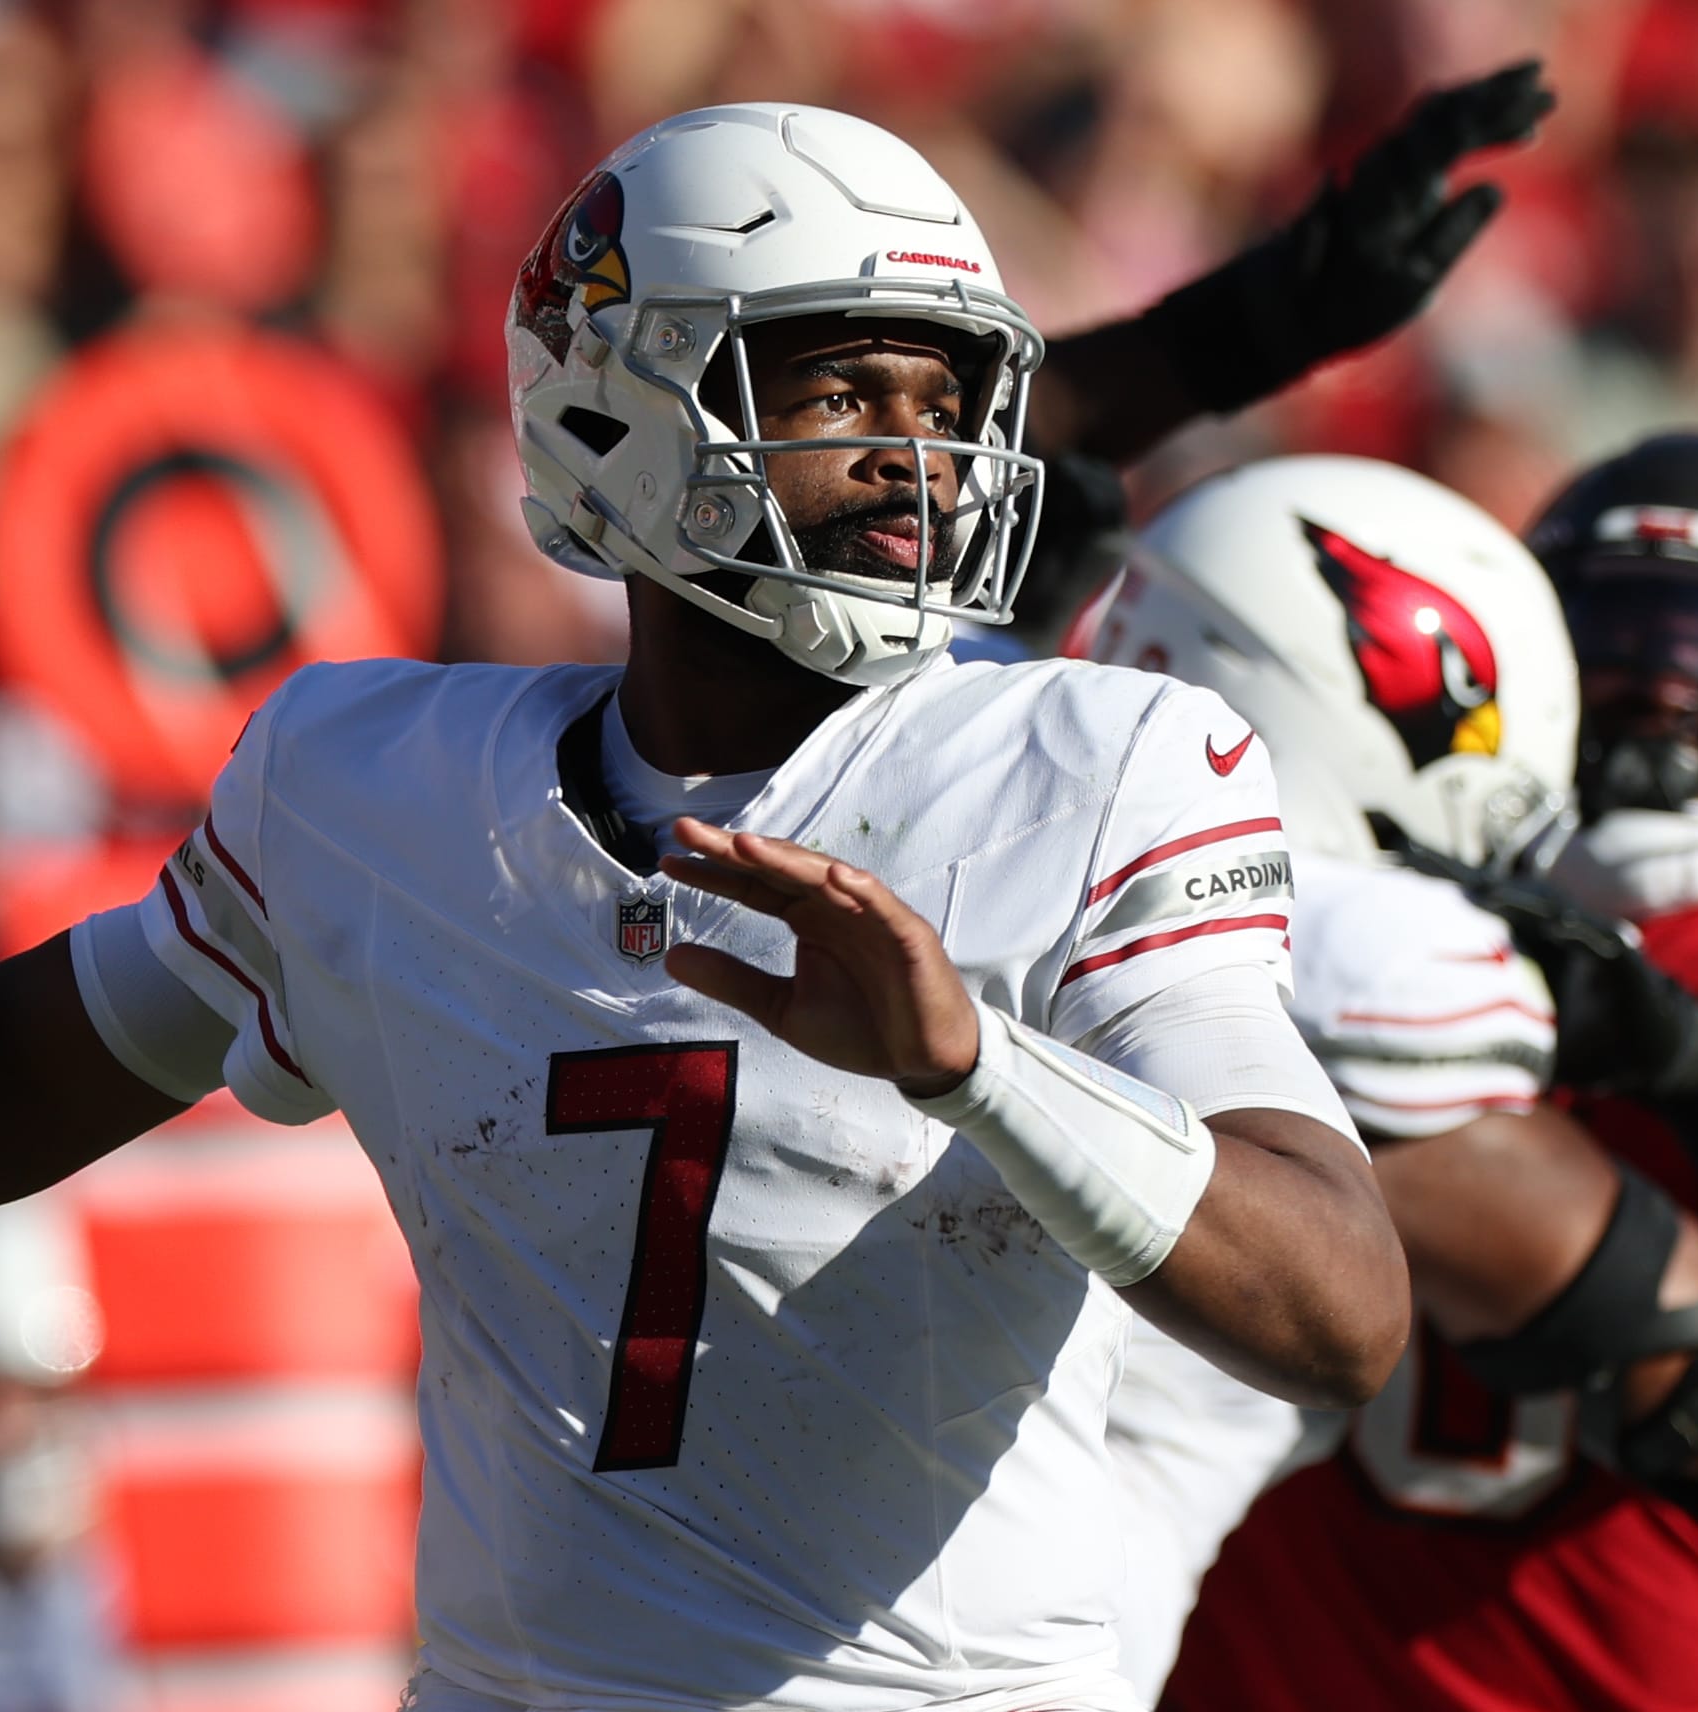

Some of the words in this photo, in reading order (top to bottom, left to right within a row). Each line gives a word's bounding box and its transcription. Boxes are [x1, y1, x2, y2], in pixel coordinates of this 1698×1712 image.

[886, 250, 982, 274] CARDINALS
[622, 925, 661, 955] NFL
[546, 1039, 739, 1473] 7
